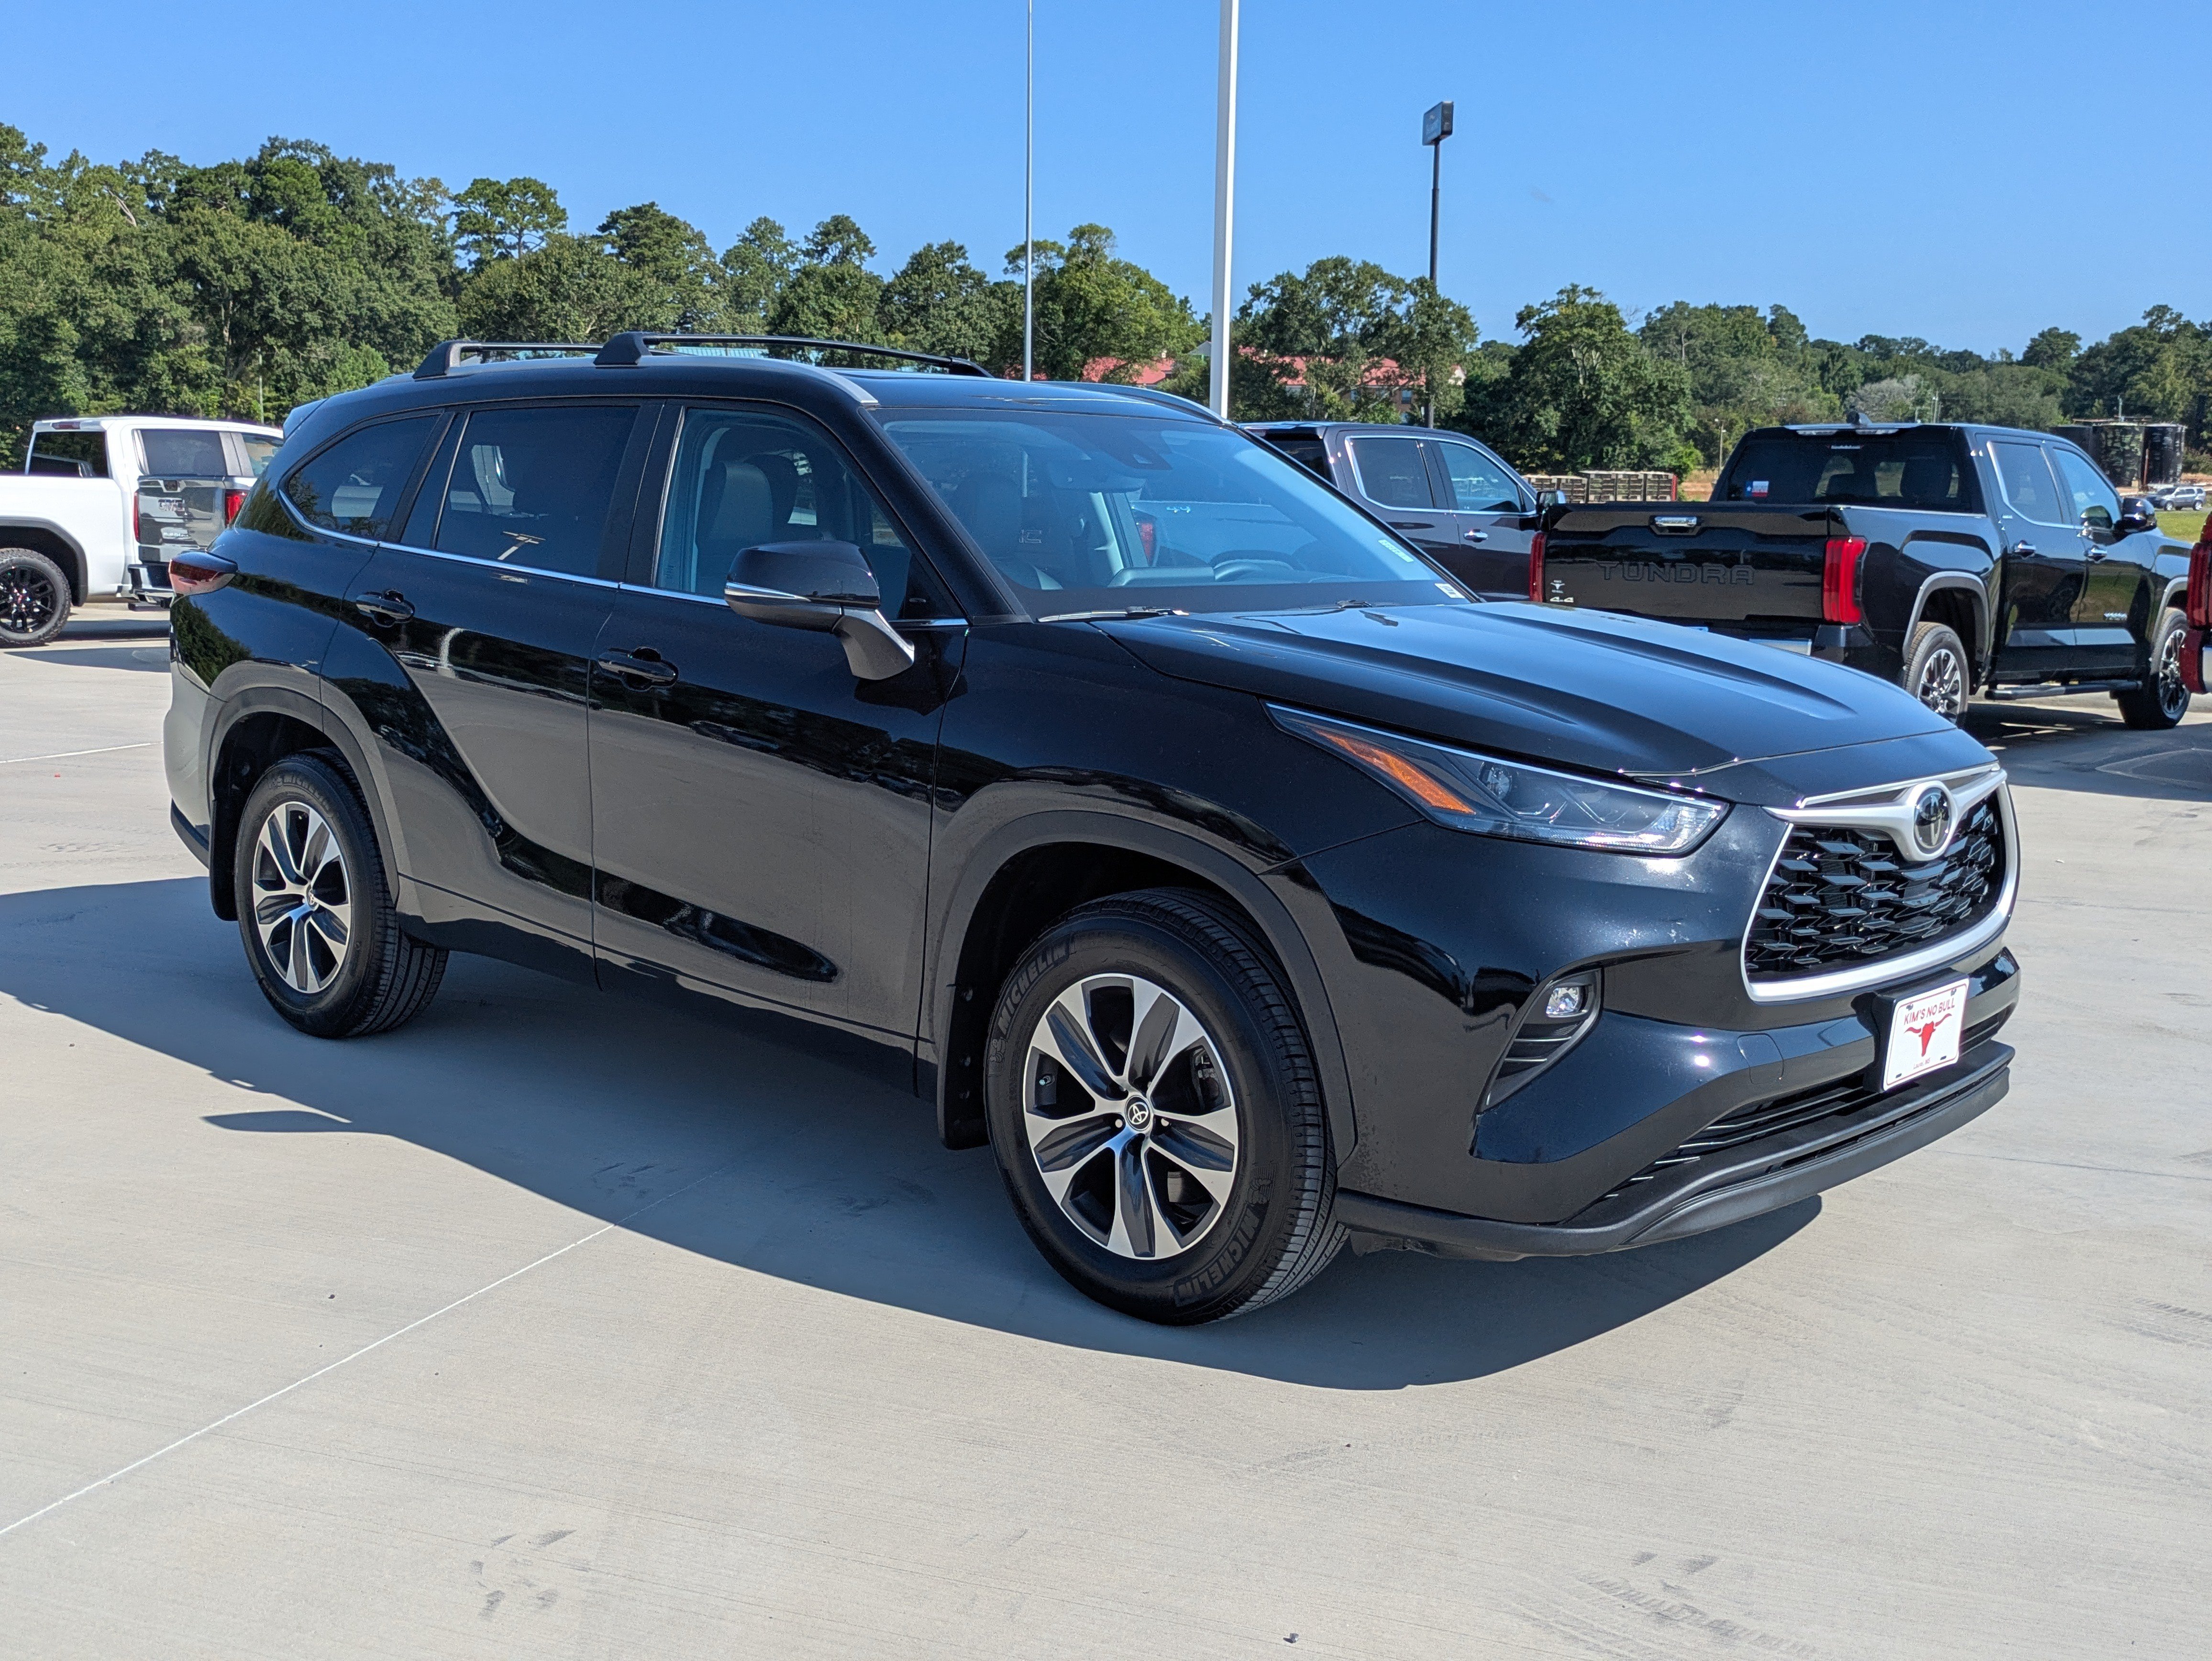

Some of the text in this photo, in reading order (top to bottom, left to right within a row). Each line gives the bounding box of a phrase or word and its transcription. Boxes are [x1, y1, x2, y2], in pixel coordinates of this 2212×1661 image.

[1597, 561, 1756, 585] TUNDRA
[998, 939, 1066, 1035] MICHELIN
[1903, 997, 1955, 1026] KIM'S NO BULL
[1177, 1208, 1260, 1296] MICHELIN
